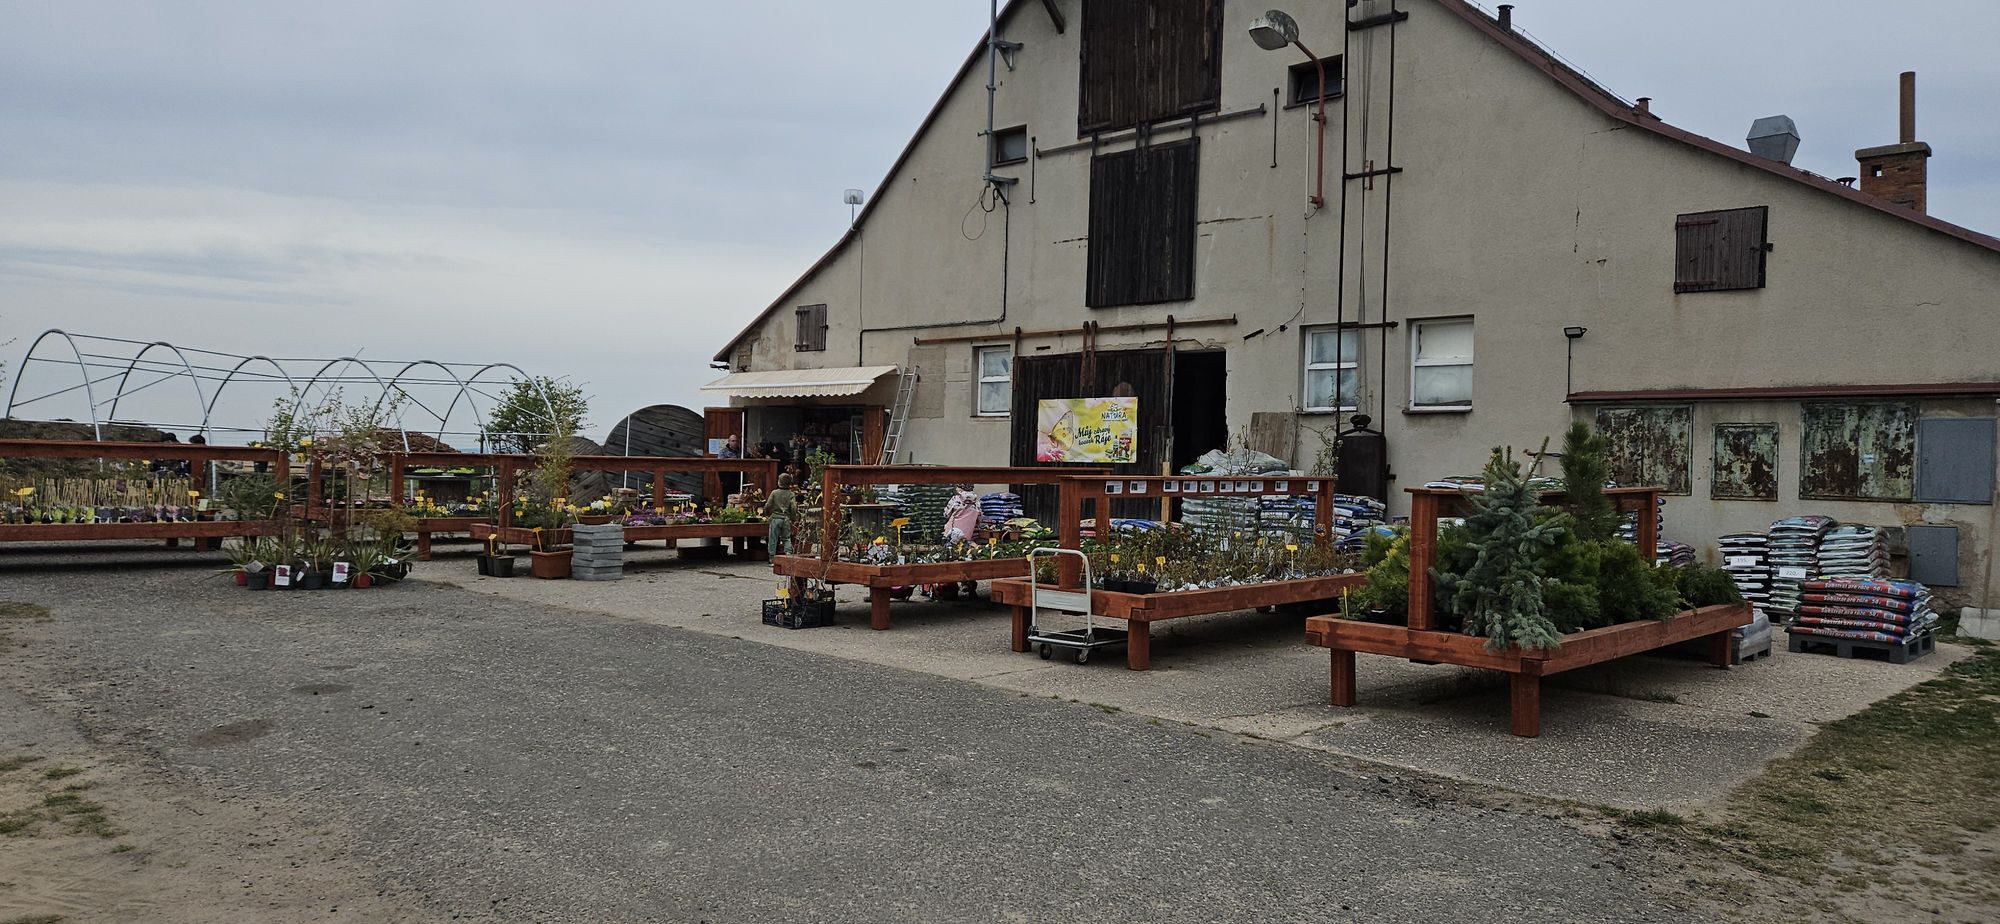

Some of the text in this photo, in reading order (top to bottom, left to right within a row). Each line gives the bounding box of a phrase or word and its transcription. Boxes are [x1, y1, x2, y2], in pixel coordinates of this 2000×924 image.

[1101, 411, 1127, 419] NATURA
[1075, 425, 1092, 439] Můj
[1094, 433, 1112, 446] Ráje
